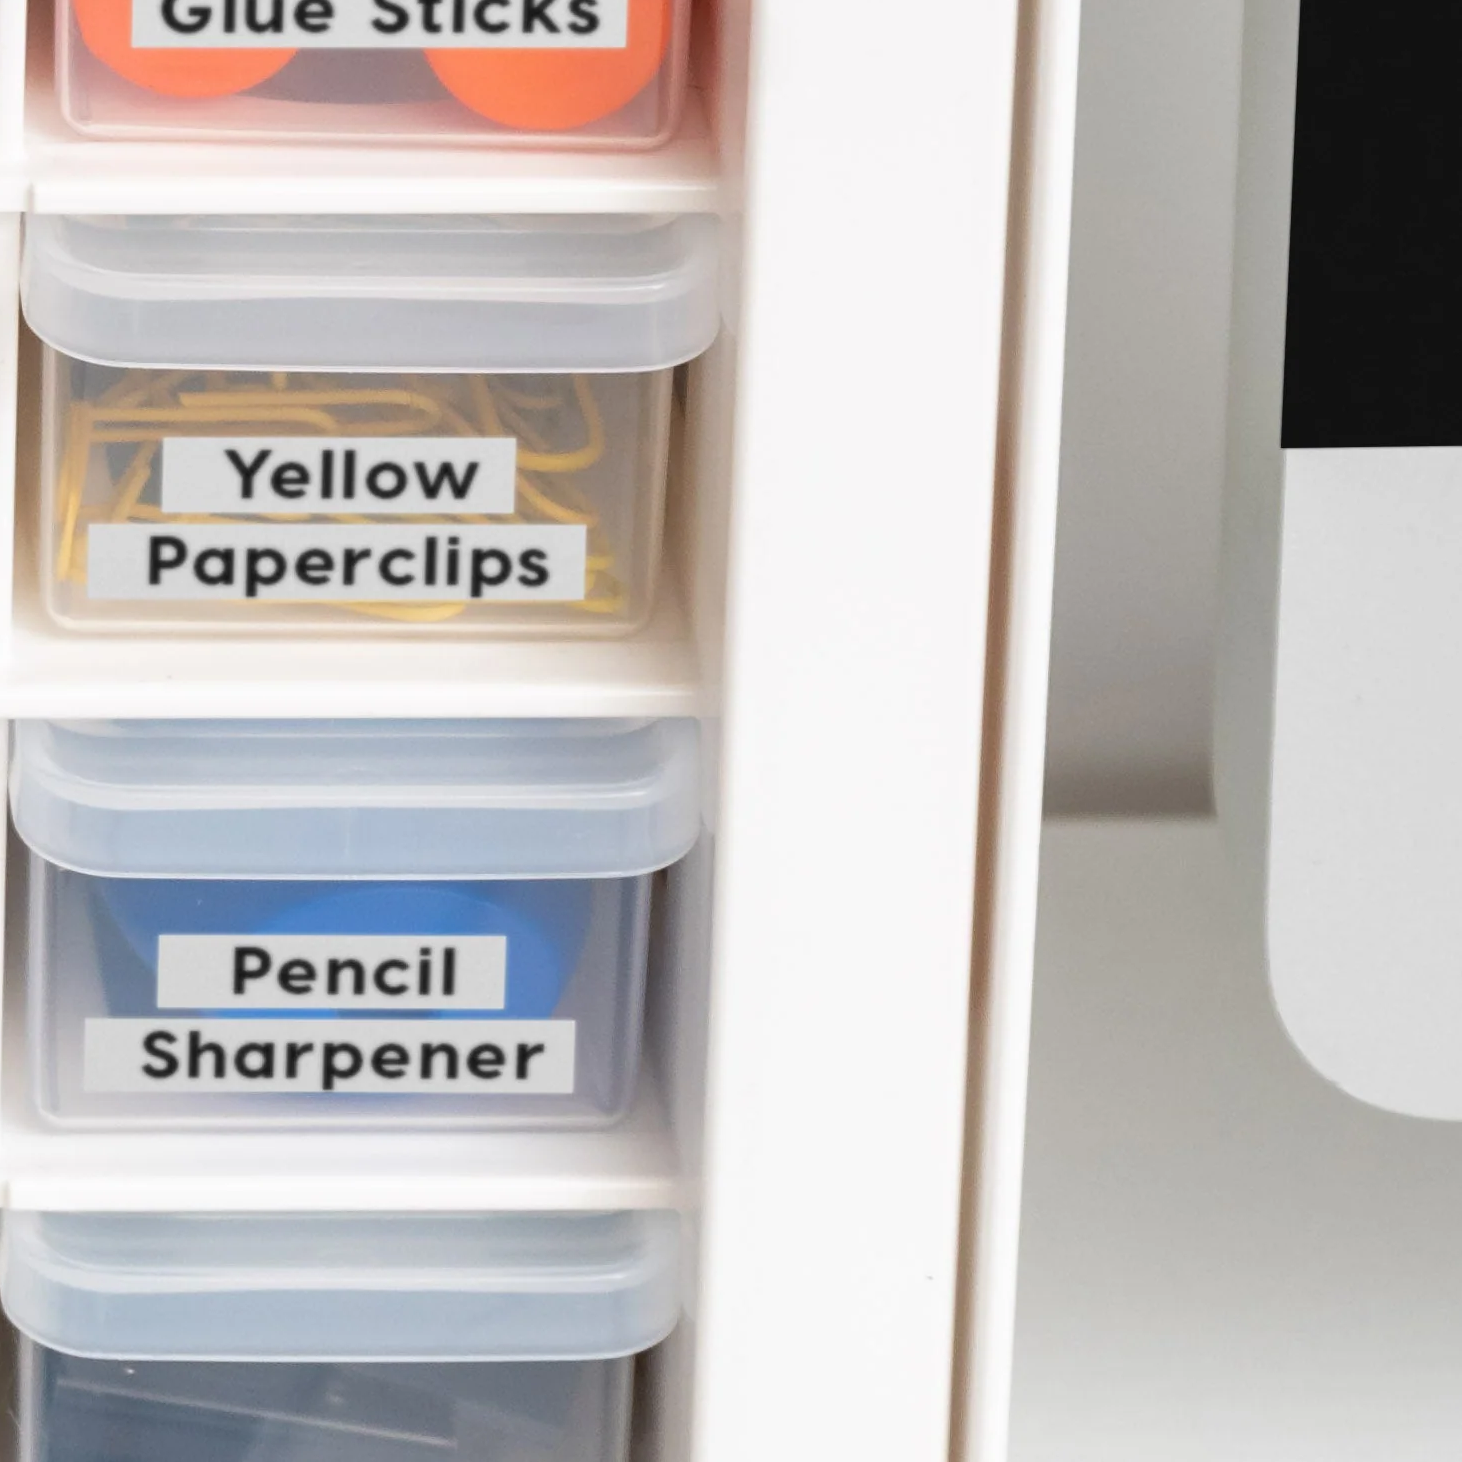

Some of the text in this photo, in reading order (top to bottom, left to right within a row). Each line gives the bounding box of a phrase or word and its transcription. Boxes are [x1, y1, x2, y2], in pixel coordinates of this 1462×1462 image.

[223, 447, 481, 502] Yellow
[147, 533, 551, 600] Paperclips
[231, 944, 458, 998] Pencil
[140, 1028, 547, 1093] Sharpener
